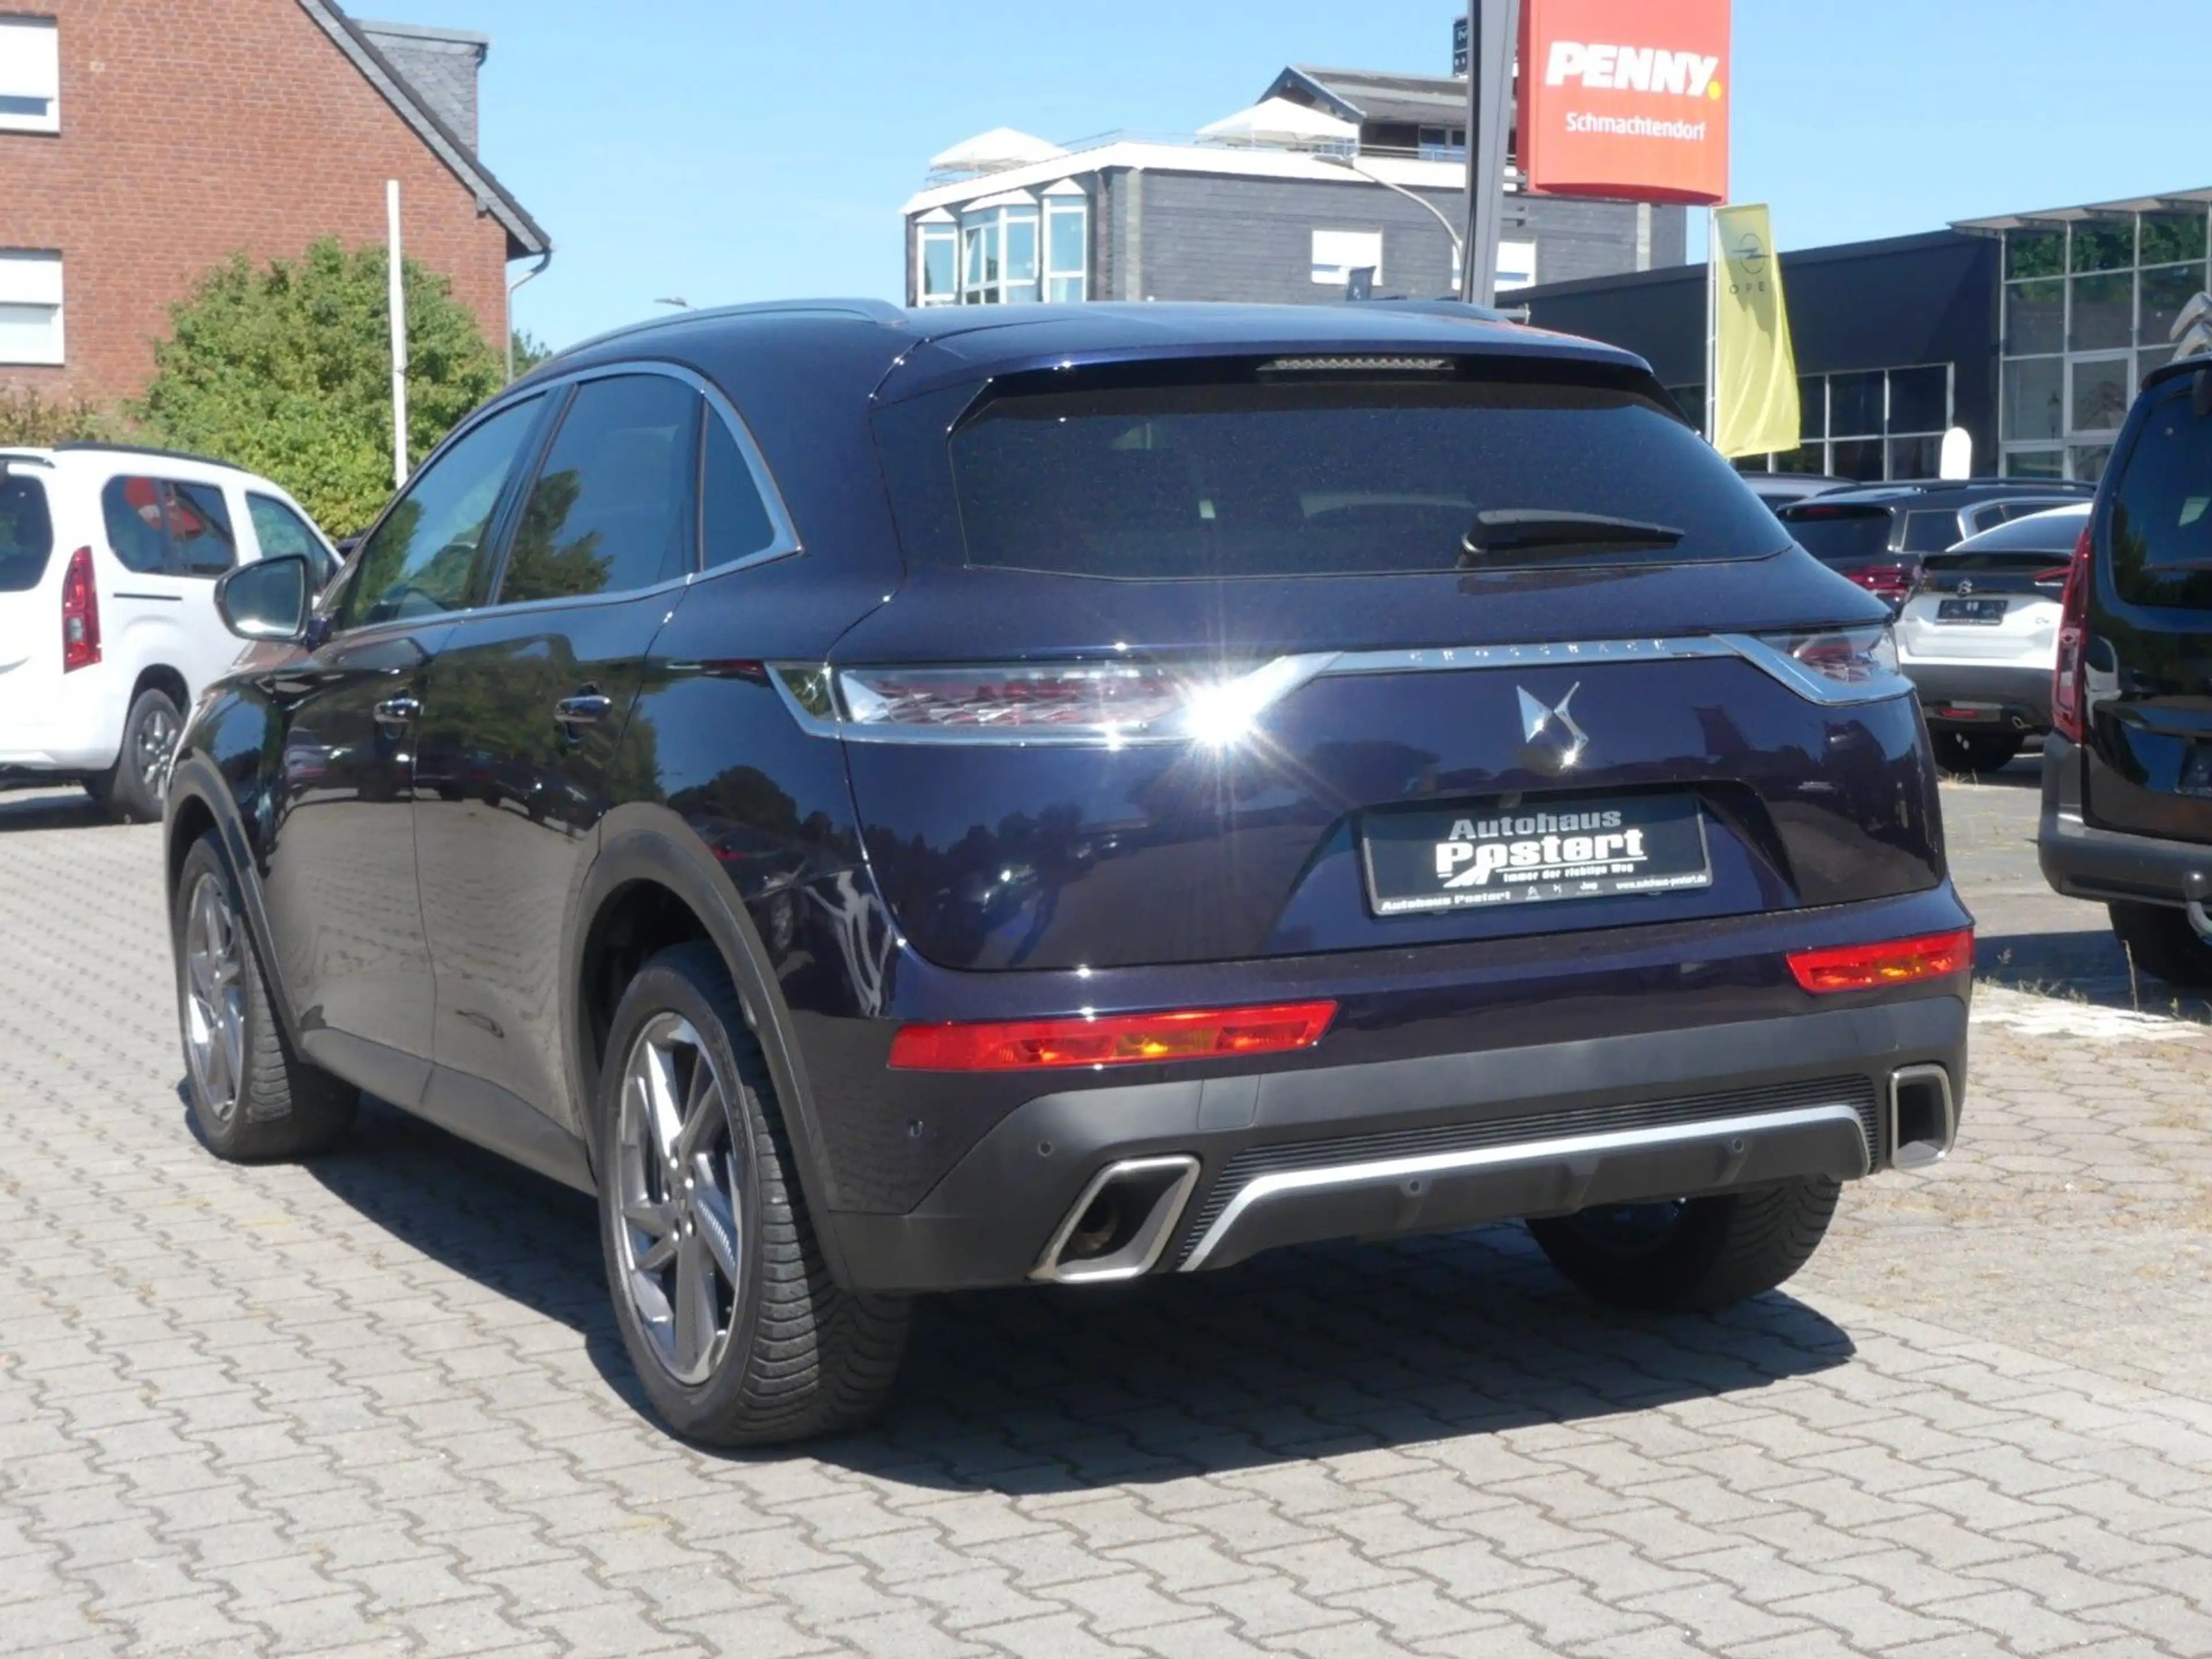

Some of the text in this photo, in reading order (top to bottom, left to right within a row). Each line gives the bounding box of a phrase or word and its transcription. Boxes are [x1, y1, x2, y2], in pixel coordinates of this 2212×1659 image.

[1565, 112, 1707, 141] Schmachtendorf
[1448, 811, 1622, 840] Autohaus
[1435, 828, 1643, 884] Postert
[1381, 897, 1452, 911] Autohaus
